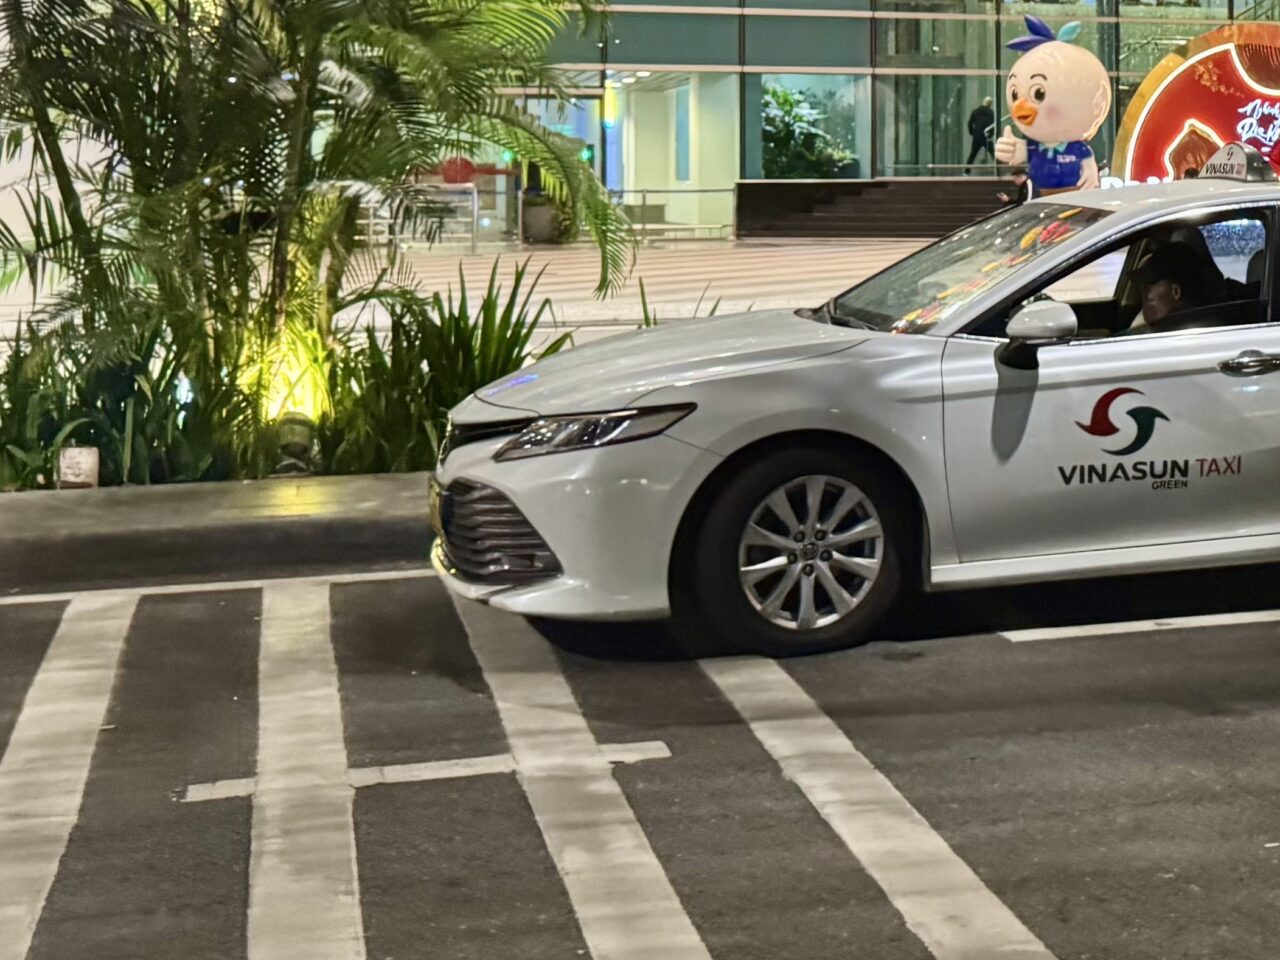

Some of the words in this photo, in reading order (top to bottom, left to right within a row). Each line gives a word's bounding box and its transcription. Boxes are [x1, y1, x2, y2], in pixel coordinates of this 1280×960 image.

[1205, 162, 1235, 175] VINASUN
[1058, 459, 1189, 485] VINASUN
[1195, 455, 1242, 478] TAXI
[1151, 479, 1188, 490] GREEN
